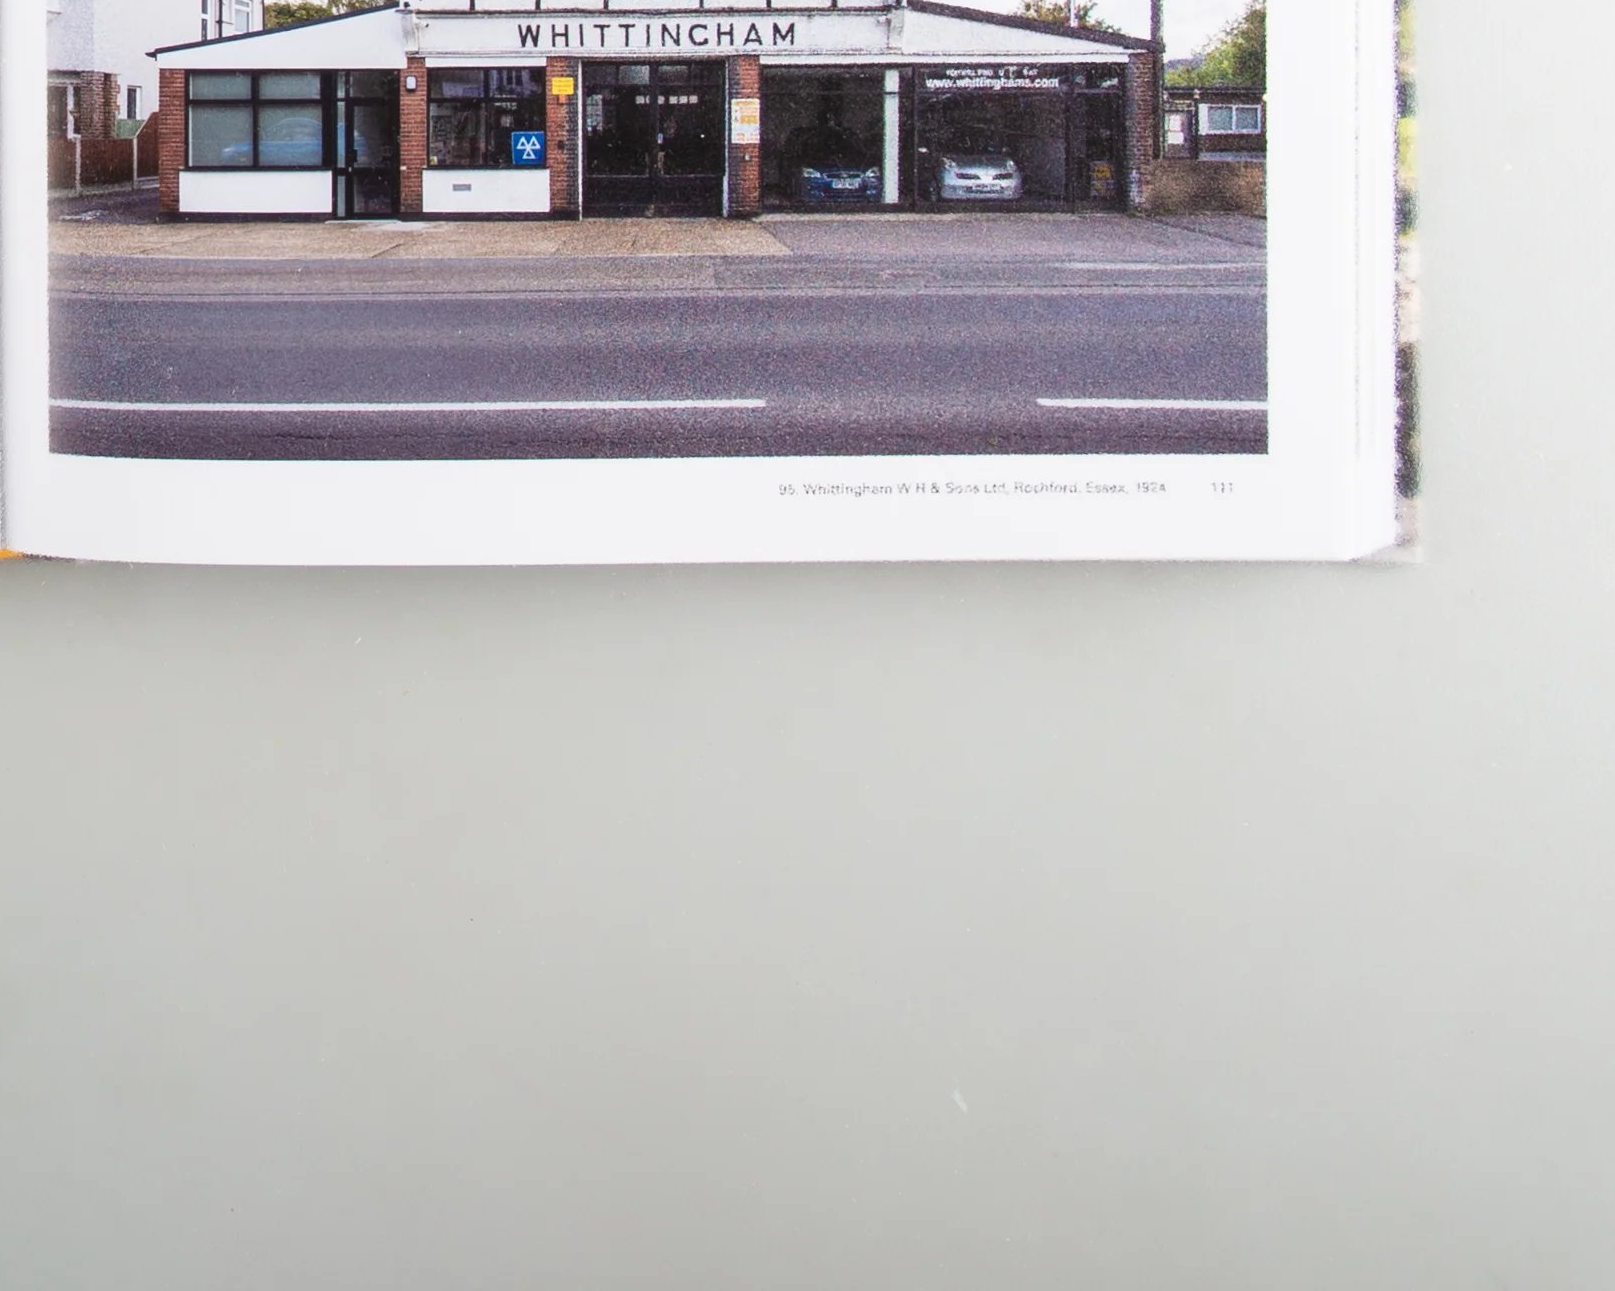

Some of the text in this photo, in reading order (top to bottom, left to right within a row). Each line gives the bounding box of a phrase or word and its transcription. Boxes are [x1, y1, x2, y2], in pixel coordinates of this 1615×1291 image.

[517, 22, 796, 48] WHITTINGHAM
[802, 482, 893, 497] Whittingham
[897, 482, 912, 495] W
[916, 482, 926, 494] H
[930, 482, 940, 494] &
[945, 482, 980, 494] Sons
